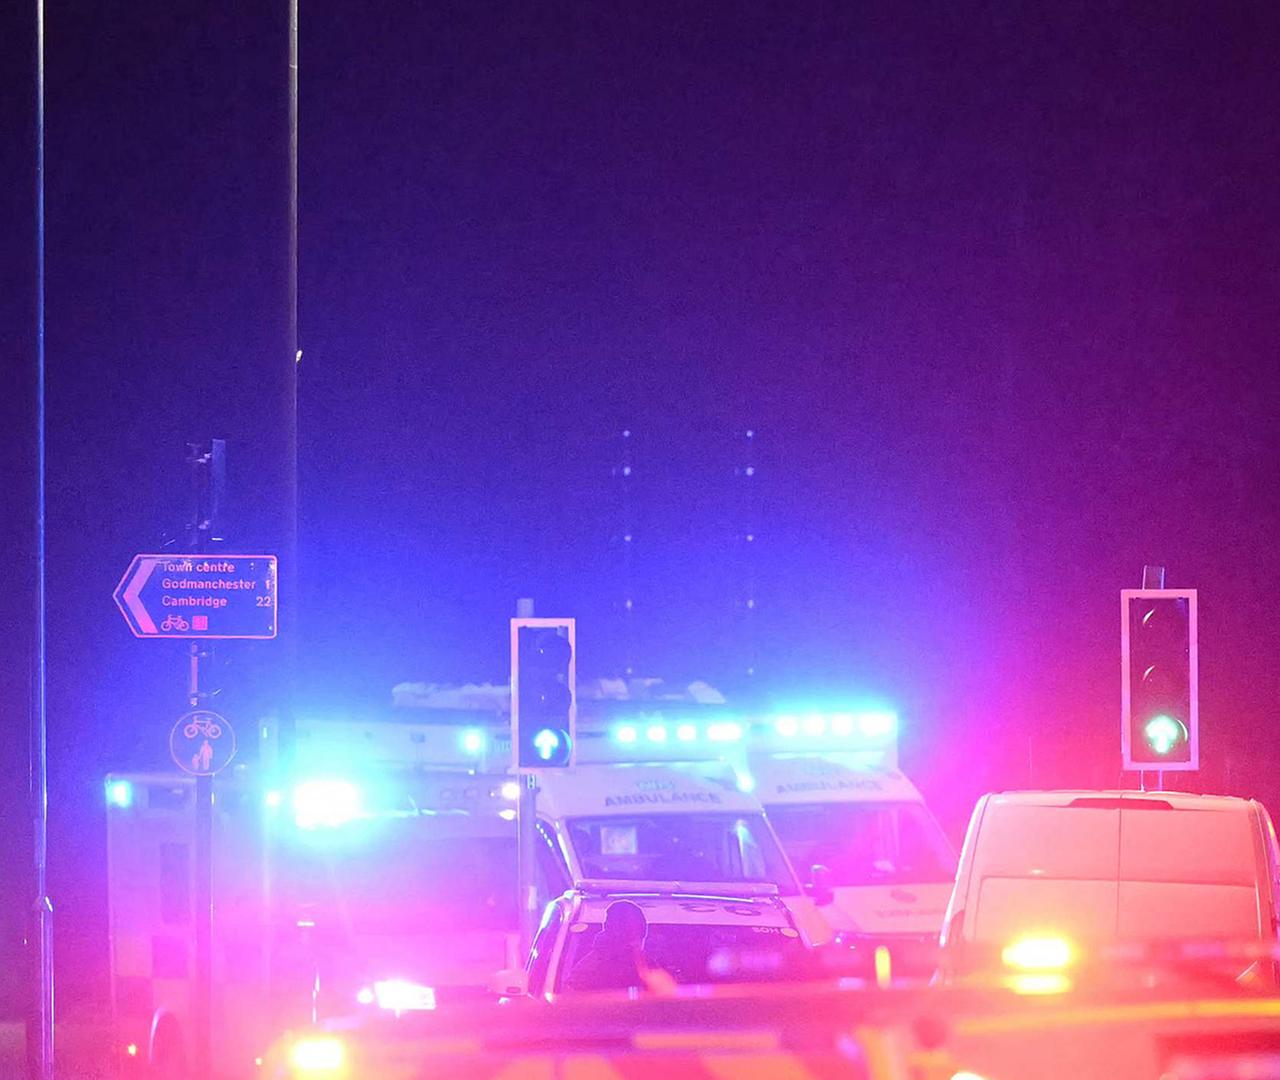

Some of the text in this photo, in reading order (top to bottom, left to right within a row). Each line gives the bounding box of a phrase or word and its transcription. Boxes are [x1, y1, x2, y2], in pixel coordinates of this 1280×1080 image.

[162, 560, 235, 573] Town centre
[162, 578, 256, 590] Godmanchester
[162, 595, 272, 609] Cambridge 22
[604, 790, 723, 808] AMBULANCE
